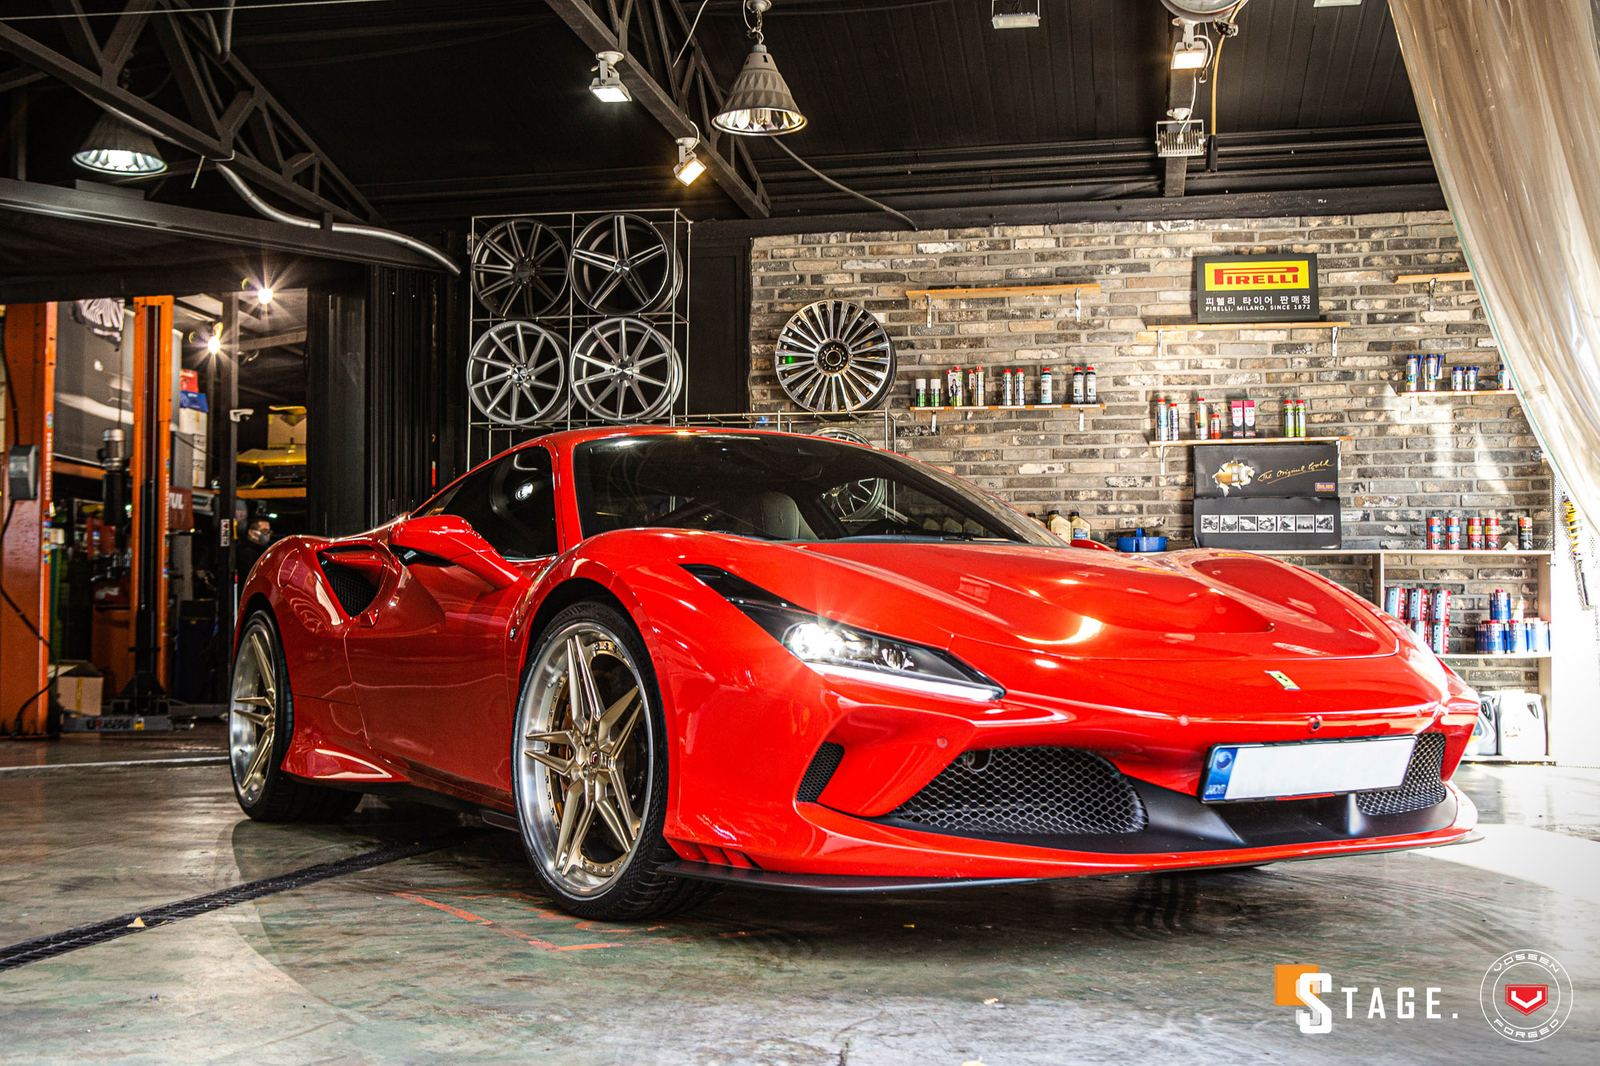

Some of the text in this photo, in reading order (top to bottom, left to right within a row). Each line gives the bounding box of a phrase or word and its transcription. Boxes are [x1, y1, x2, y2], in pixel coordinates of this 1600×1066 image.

[1214, 267, 1299, 285] PIRELLI
[1205, 295, 1311, 306] 피렐리 타이어 판매점
[1257, 470, 1273, 482] The
